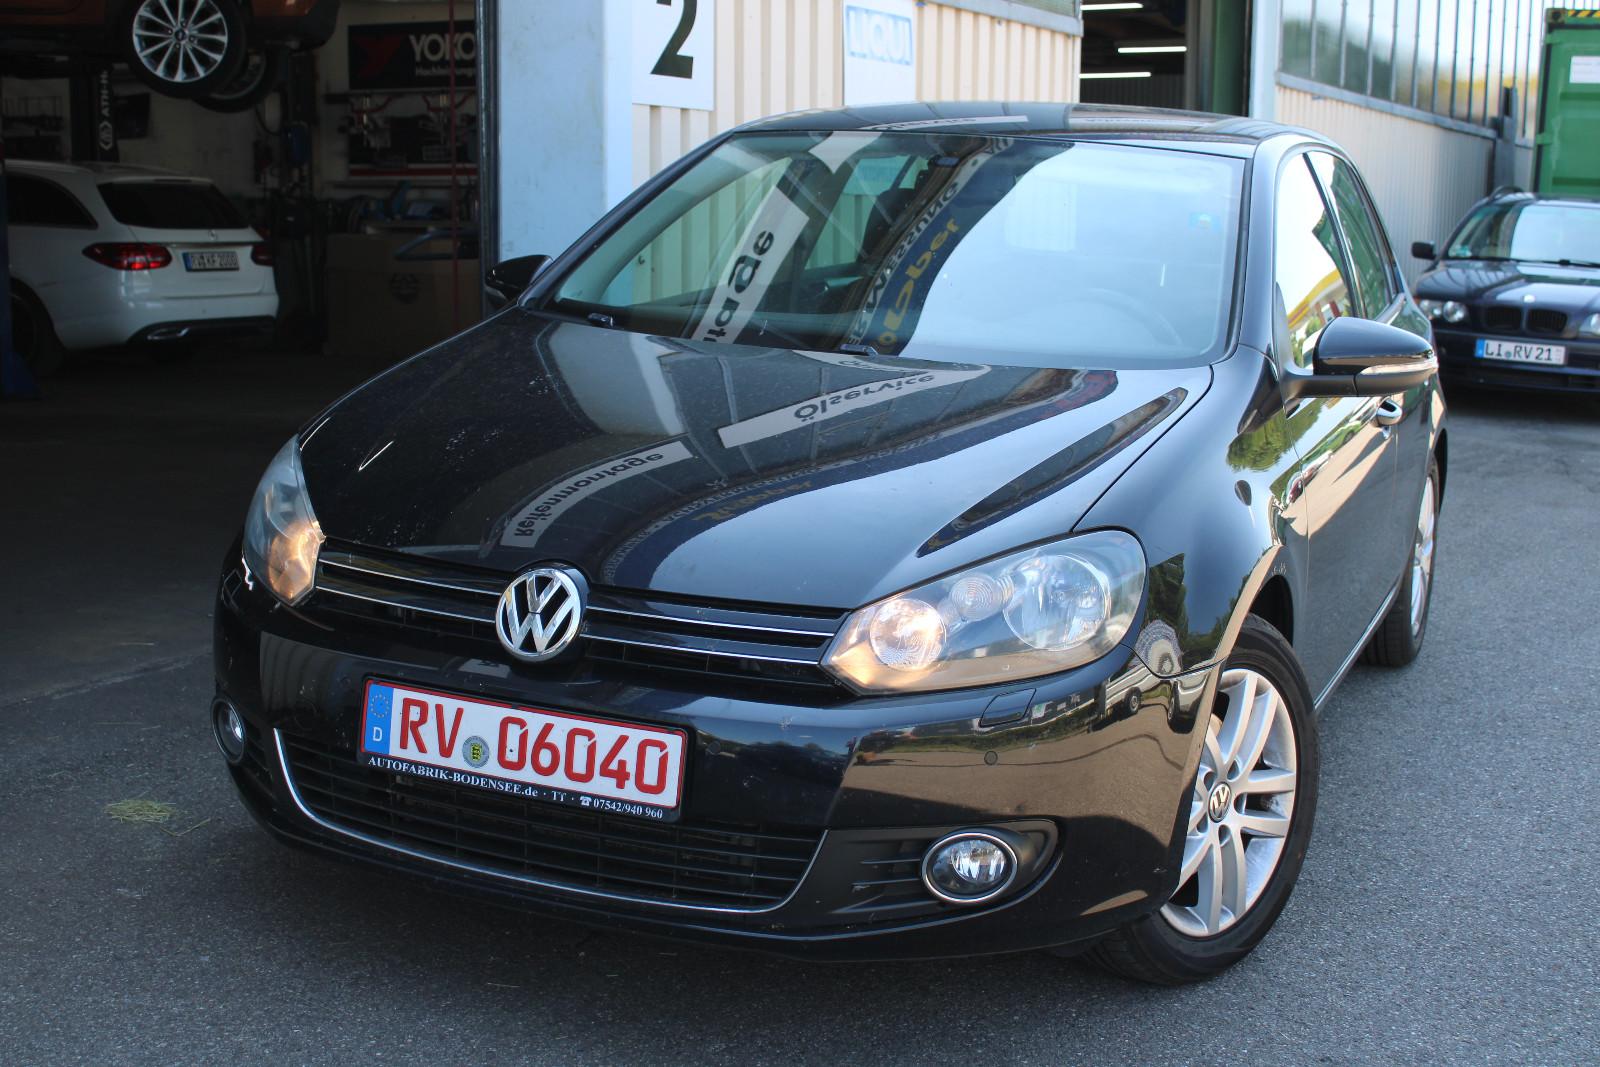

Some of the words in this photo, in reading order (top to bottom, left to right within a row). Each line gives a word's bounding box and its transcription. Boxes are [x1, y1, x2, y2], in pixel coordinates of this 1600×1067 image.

[650, 0, 698, 79] 2
[848, 7, 911, 64] LIQUI
[372, 726, 383, 742] D
[400, 697, 464, 758] RV
[497, 716, 668, 795] 06040
